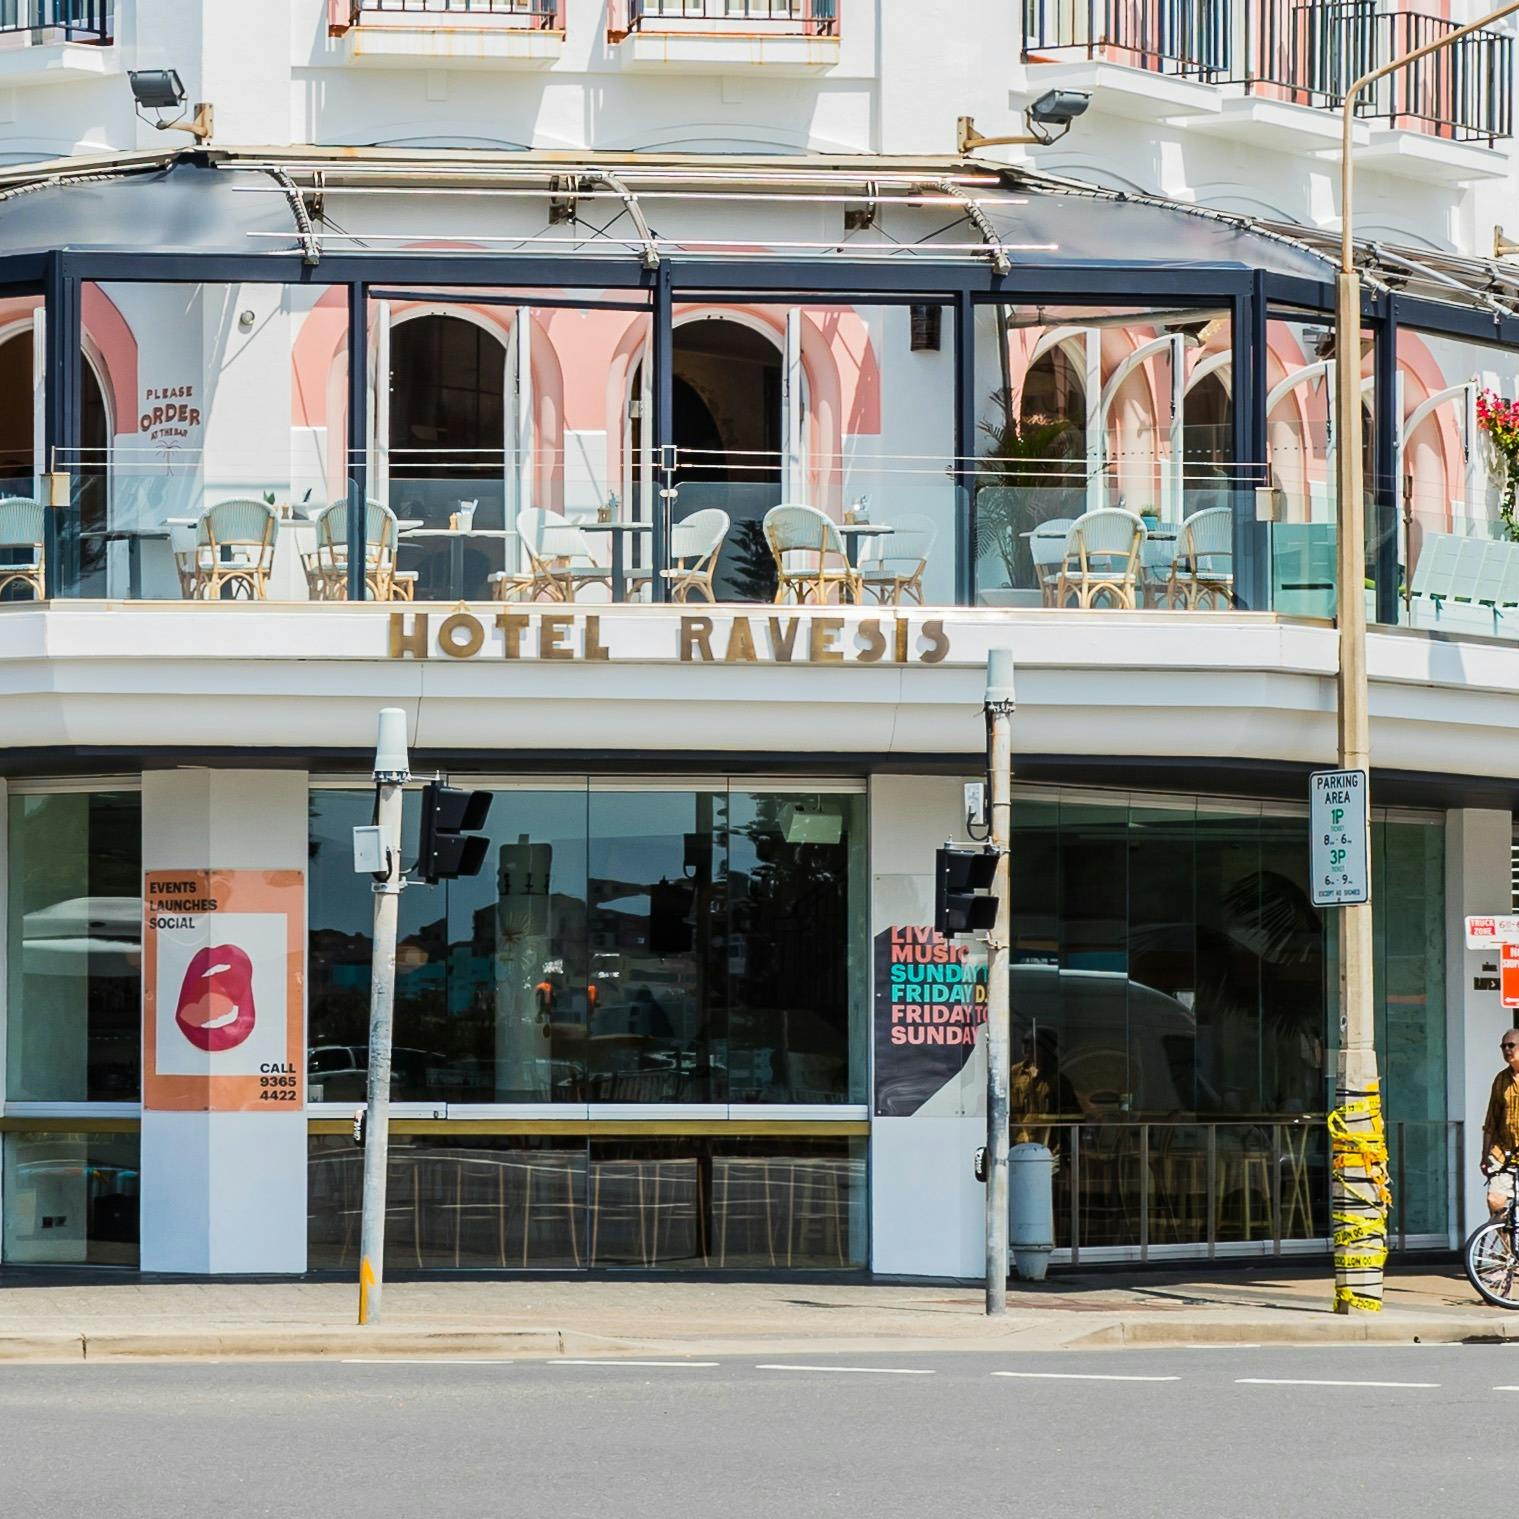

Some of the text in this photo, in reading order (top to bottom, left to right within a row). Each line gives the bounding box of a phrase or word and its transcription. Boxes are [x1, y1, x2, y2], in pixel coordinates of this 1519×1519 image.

[146, 386, 192, 400] PLEASE
[140, 403, 200, 432] ORDER
[150, 430, 158, 440] AT
[160, 428, 173, 437] THE
[389, 612, 950, 664] HOTEL RAVESIS
[1317, 775, 1358, 790] PARKING
[1325, 791, 1351, 805] AREA
[1331, 808, 1344, 824] 1P
[1330, 849, 1346, 864] 3P
[149, 881, 197, 894] EVENTS
[149, 899, 218, 912] LAUNCHES
[149, 916, 196, 929] SOCIAL
[1471, 919, 1495, 927] TRUCK
[890, 926, 947, 944] LIVE
[1473, 927, 1493, 935] ZONE
[891, 944, 969, 964] MUSIC
[890, 964, 978, 983] SUNDAY
[891, 984, 973, 1003] FRIDAY
[891, 1004, 972, 1023] FRIDAY
[890, 1025, 978, 1045] SUNDAY
[259, 1063, 297, 1074] CALL
[259, 1076, 297, 1088] 9365
[259, 1090, 297, 1101] 4422
[1347, 1256, 1361, 1266] NOT
[1362, 1256, 1372, 1265] DO
